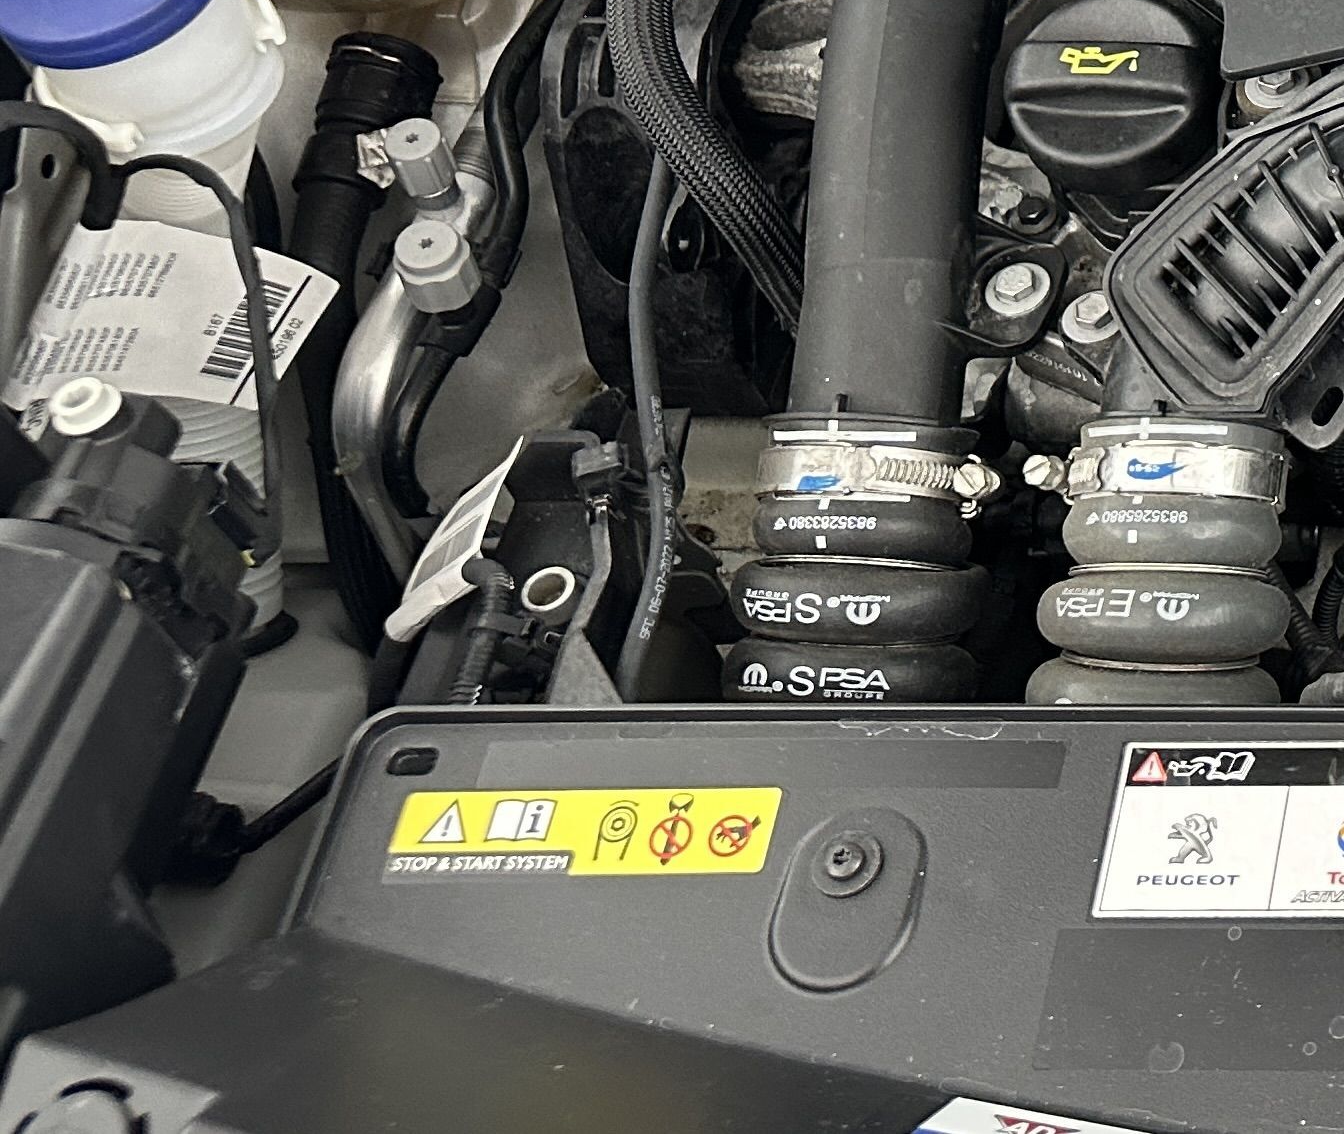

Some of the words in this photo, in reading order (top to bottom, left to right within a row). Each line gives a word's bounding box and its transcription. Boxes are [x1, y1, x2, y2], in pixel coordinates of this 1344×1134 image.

[742, 598, 792, 623] PSA
[1055, 597, 1105, 618] PSA
[818, 667, 891, 692] PSA
[390, 856, 437, 872] STOP
[435, 857, 451, 871] &
[451, 855, 506, 871] START
[503, 855, 570, 871] SYSTEM
[1136, 874, 1241, 886] PEUGEOT
